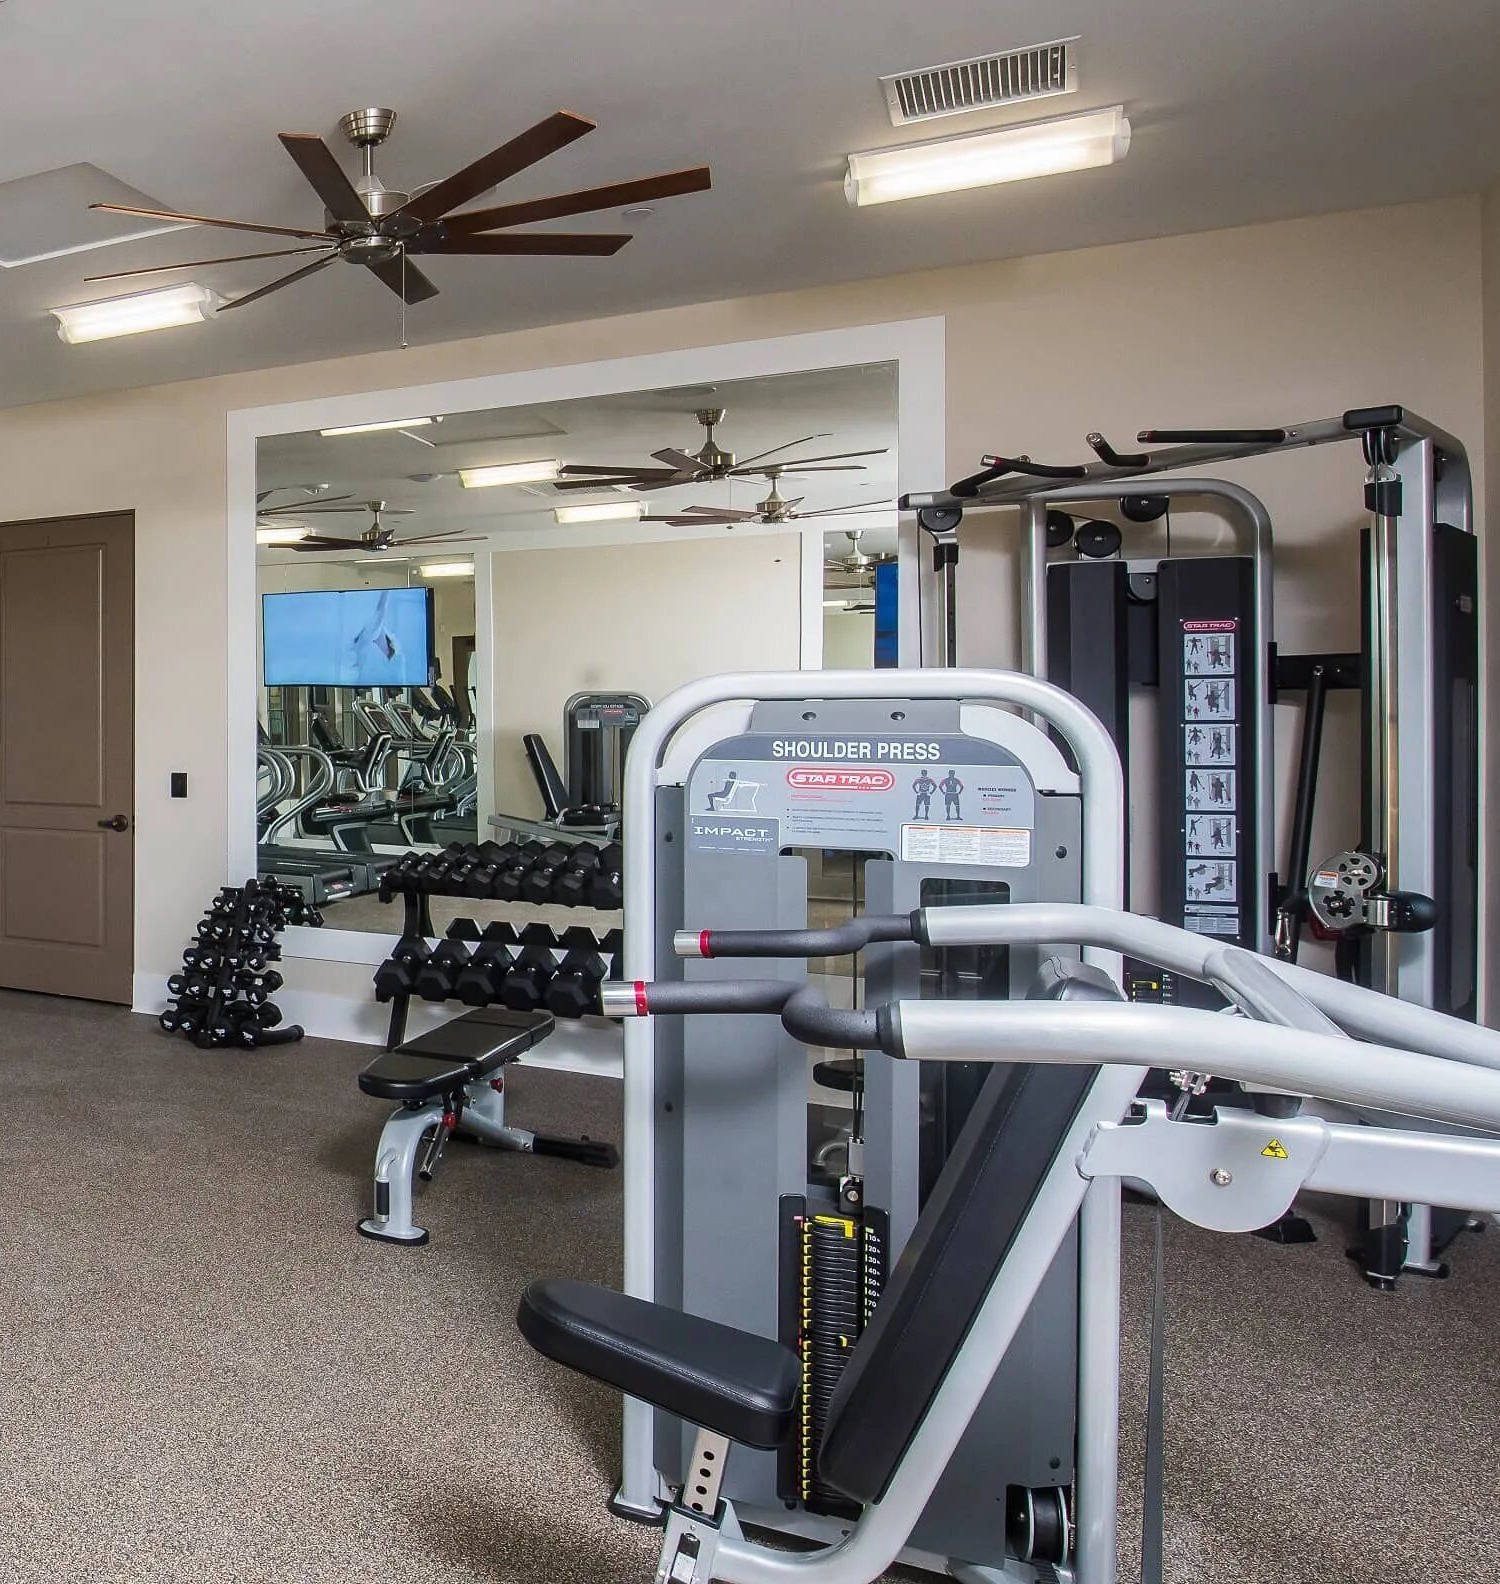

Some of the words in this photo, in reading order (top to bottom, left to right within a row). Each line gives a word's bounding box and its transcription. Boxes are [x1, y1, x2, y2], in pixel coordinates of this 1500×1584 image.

[772, 740, 872, 759] SHOULDER
[877, 742, 941, 761] PRESS
[795, 773, 837, 784] STAR
[839, 774, 886, 785] TRAC
[693, 826, 769, 838] IMPACT
